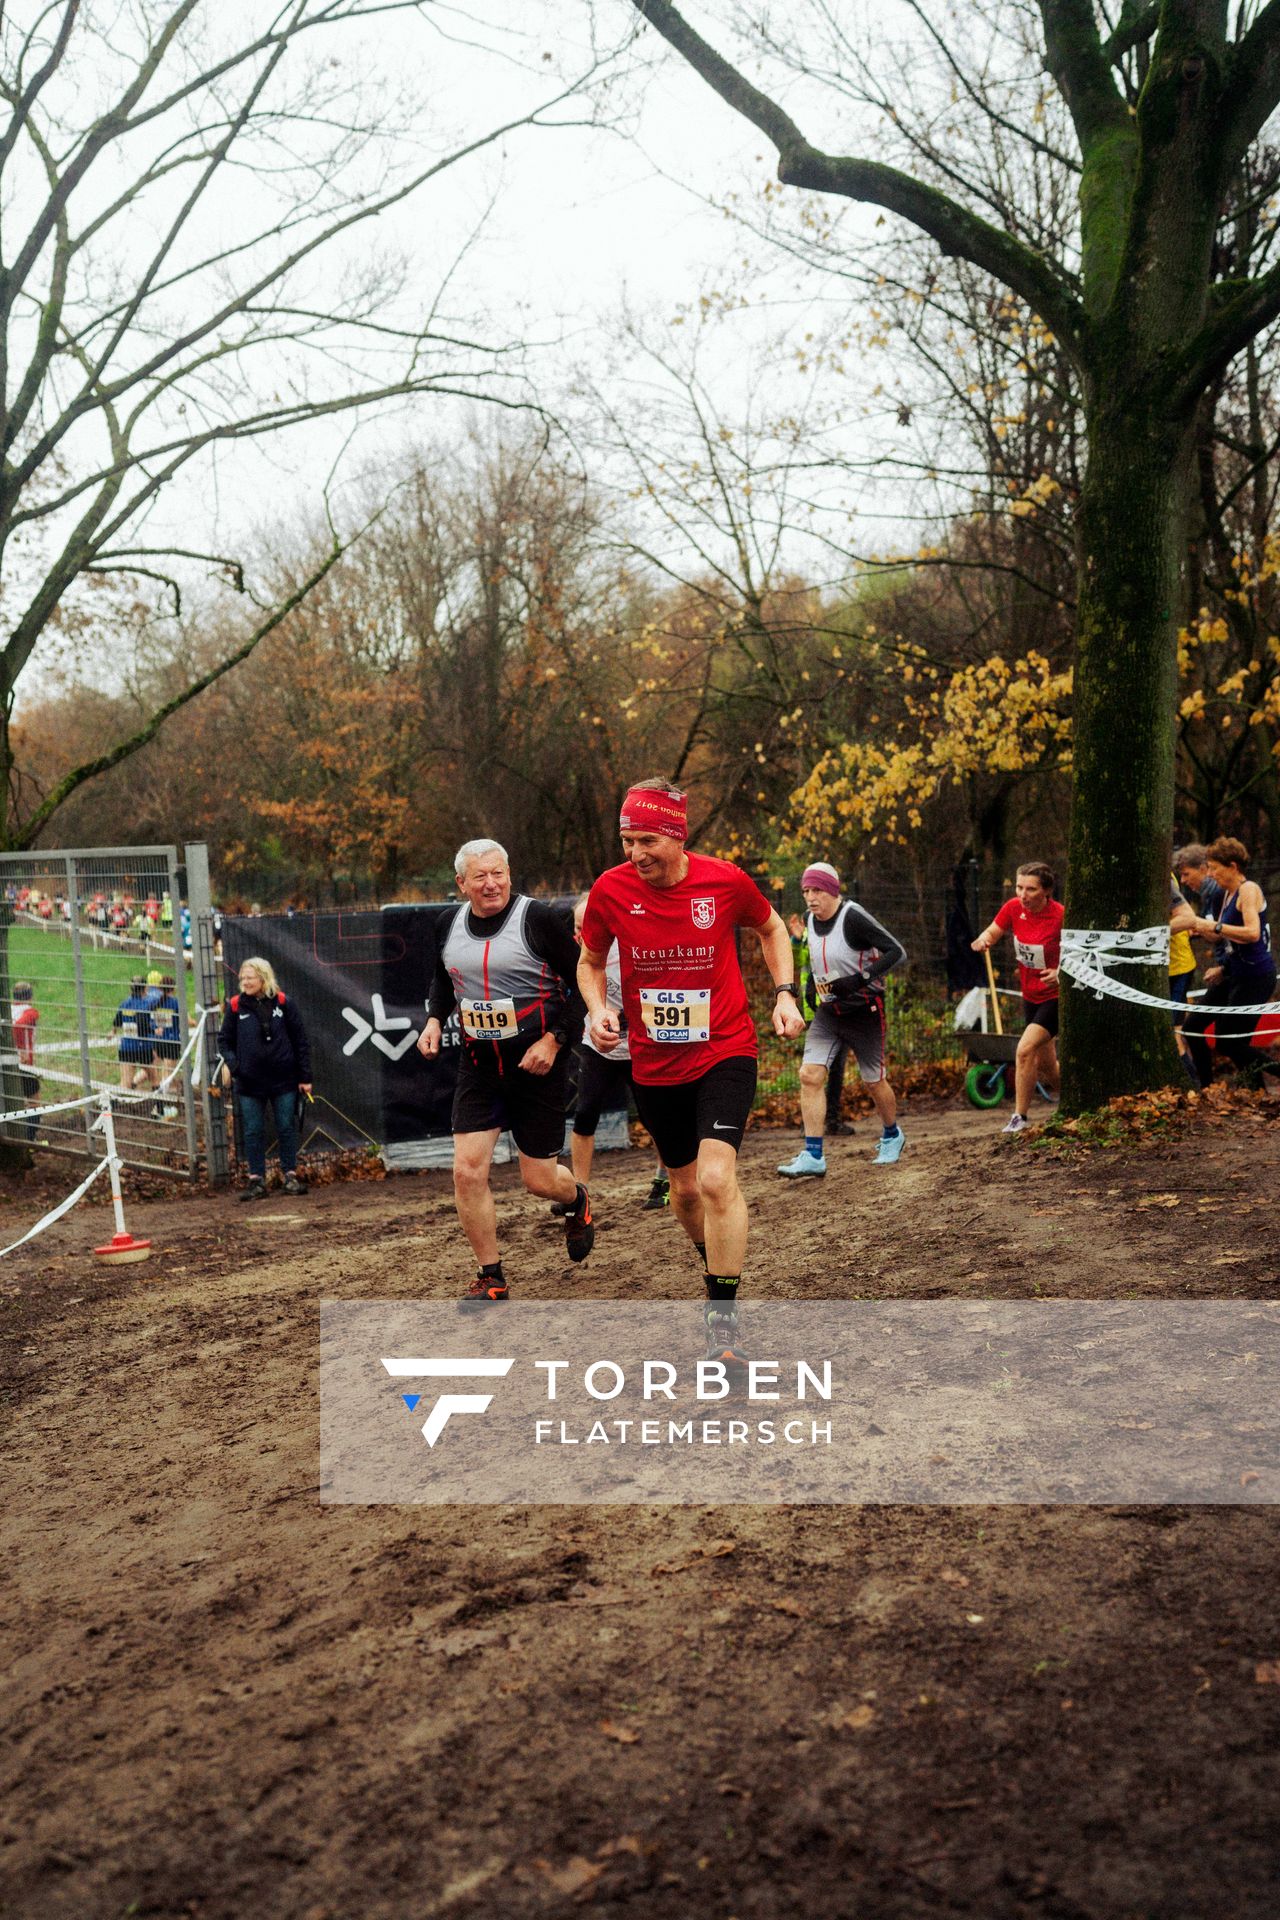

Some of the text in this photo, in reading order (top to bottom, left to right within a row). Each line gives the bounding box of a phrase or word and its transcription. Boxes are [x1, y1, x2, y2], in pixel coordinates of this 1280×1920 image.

[635, 801, 659, 811] 2017
[632, 945, 715, 959] Kreuzkamp
[468, 1012, 508, 1028] 1119
[654, 1006, 690, 1027] 591
[442, 1032, 461, 1048] ER
